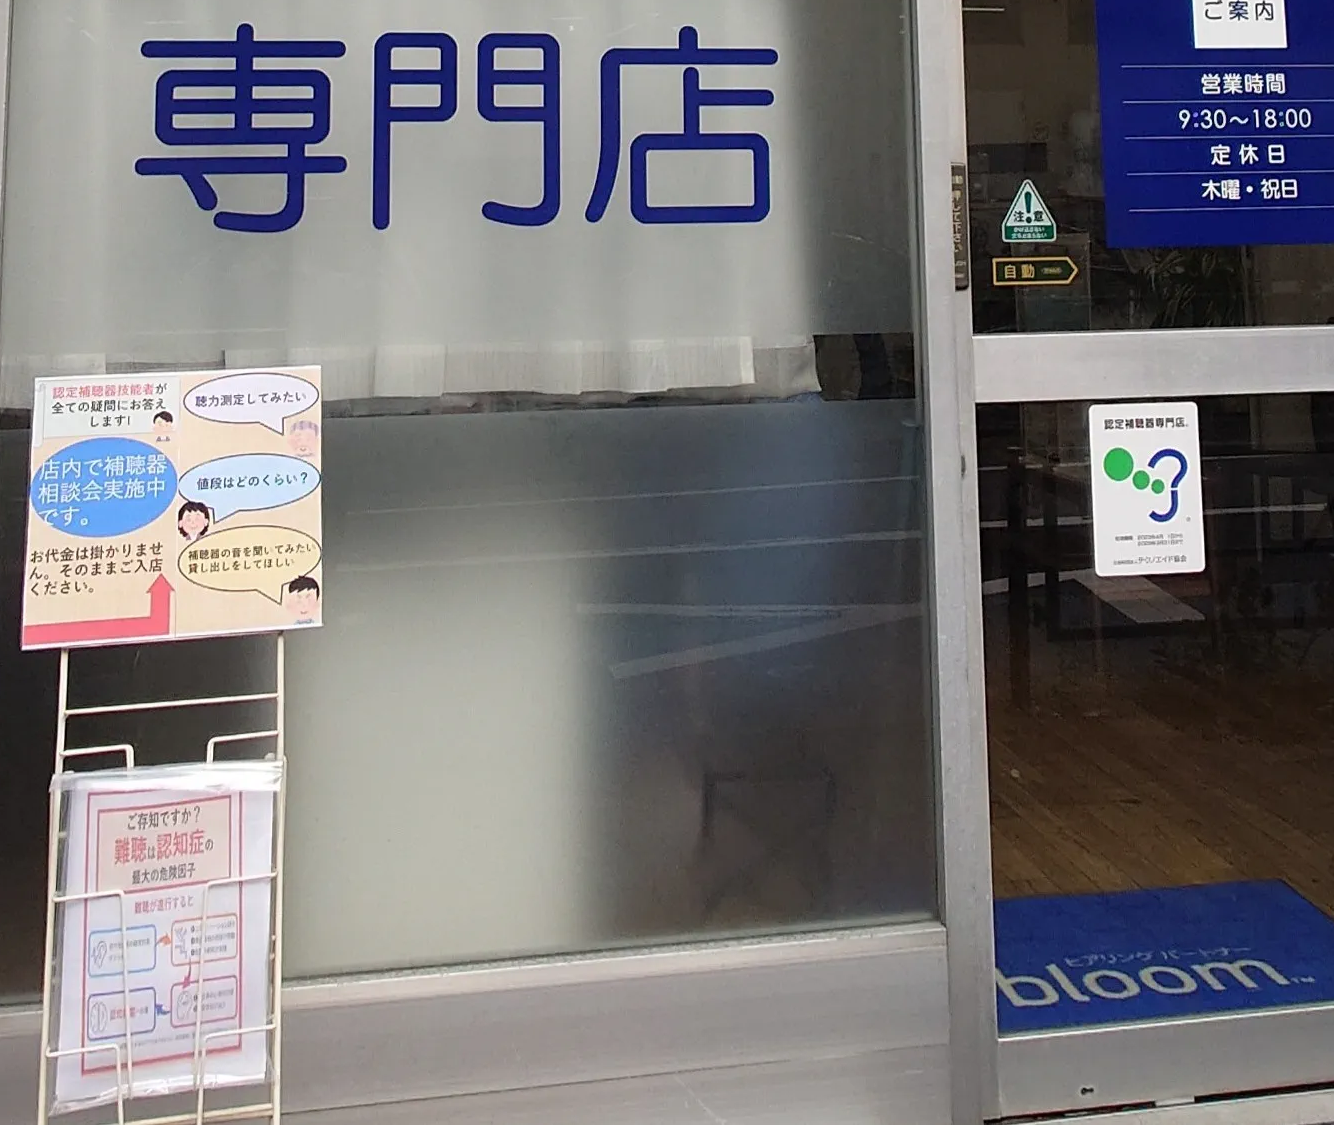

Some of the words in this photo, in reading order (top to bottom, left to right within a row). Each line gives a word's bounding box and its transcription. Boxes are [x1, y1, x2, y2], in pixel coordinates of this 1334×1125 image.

[1204, 0, 1274, 21] ご案内
[1201, 73, 1285, 95] 営業時間
[134, 23, 779, 233] 専門店
[1210, 144, 1285, 165] 定休日
[1201, 179, 1298, 200] 木曜・祝日
[1005, 264, 1035, 279] 自動
[52, 383, 167, 399] 認定補聴器技能者が
[195, 390, 307, 408] 聴力測定してみたい
[40, 454, 167, 480] 店内で補聴器
[38, 478, 166, 504] 相談会実施中
[39, 506, 90, 527] です。
[30, 543, 164, 564] お代金は掛かりませ
[188, 558, 294, 574] 貸し出しをしてほしい
[30, 581, 95, 595] ください。
[114, 830, 214, 865] 難聴は認知症の
[132, 864, 196, 885] 最大の危険因子
[995, 958, 1291, 1008] bloom
